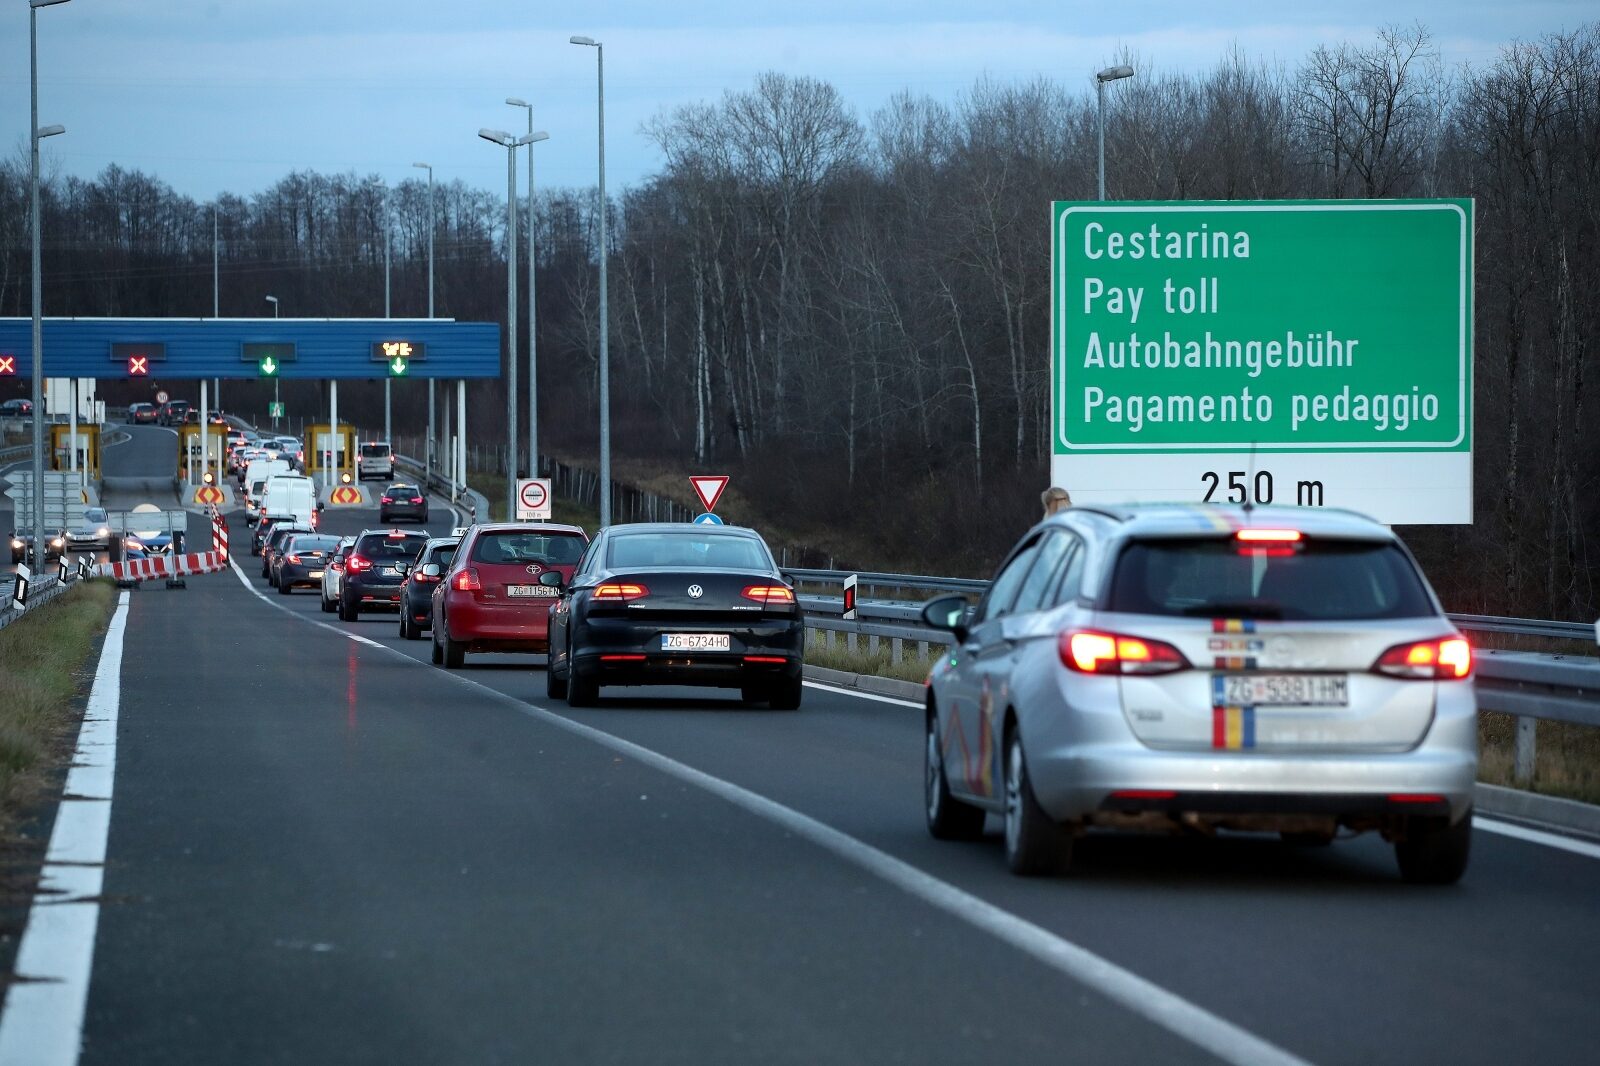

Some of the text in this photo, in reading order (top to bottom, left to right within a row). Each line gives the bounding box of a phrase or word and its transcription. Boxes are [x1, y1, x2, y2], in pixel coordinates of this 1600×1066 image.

[1084, 222, 1251, 259] Cestarina
[1084, 277, 1219, 324] Pay toll
[1083, 331, 1359, 377] Autobahngebühr
[1084, 385, 1439, 432] Pagamento pedaggio
[1201, 471, 1323, 506] 250 m
[513, 586, 524, 595] ZG
[669, 636, 682, 648] ZG
[1228, 676, 1253, 703] ZG
